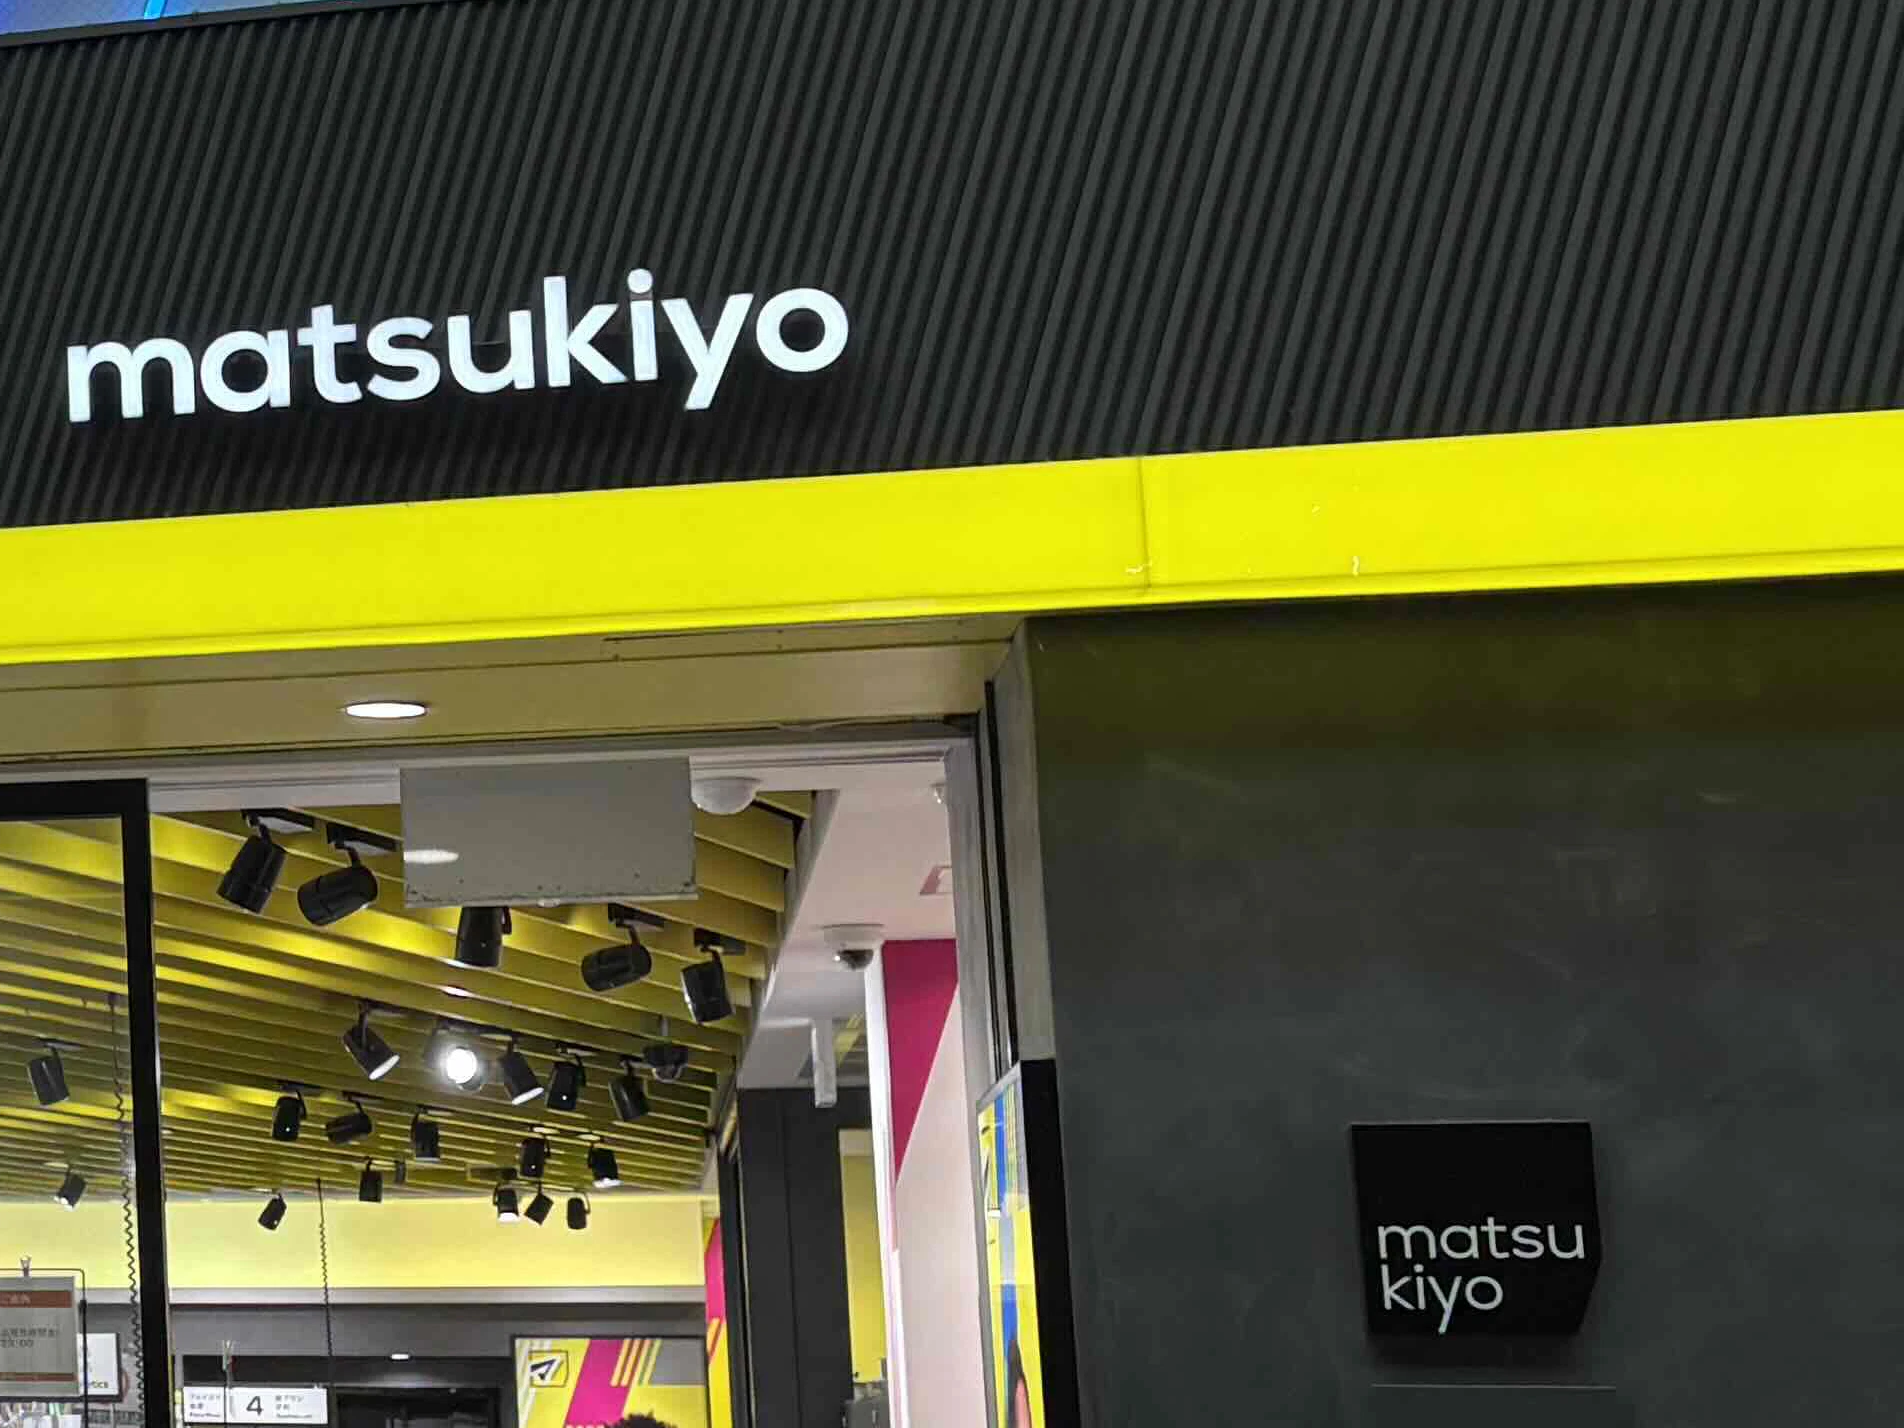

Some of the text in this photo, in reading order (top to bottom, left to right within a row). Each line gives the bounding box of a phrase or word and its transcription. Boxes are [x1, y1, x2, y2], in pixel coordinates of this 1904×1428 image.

[63, 266, 849, 424] matsukiyo
[1377, 1217, 1585, 1260] matsu
[1380, 1265, 1503, 1333] kiyo
[246, 1395, 263, 1417] 4
